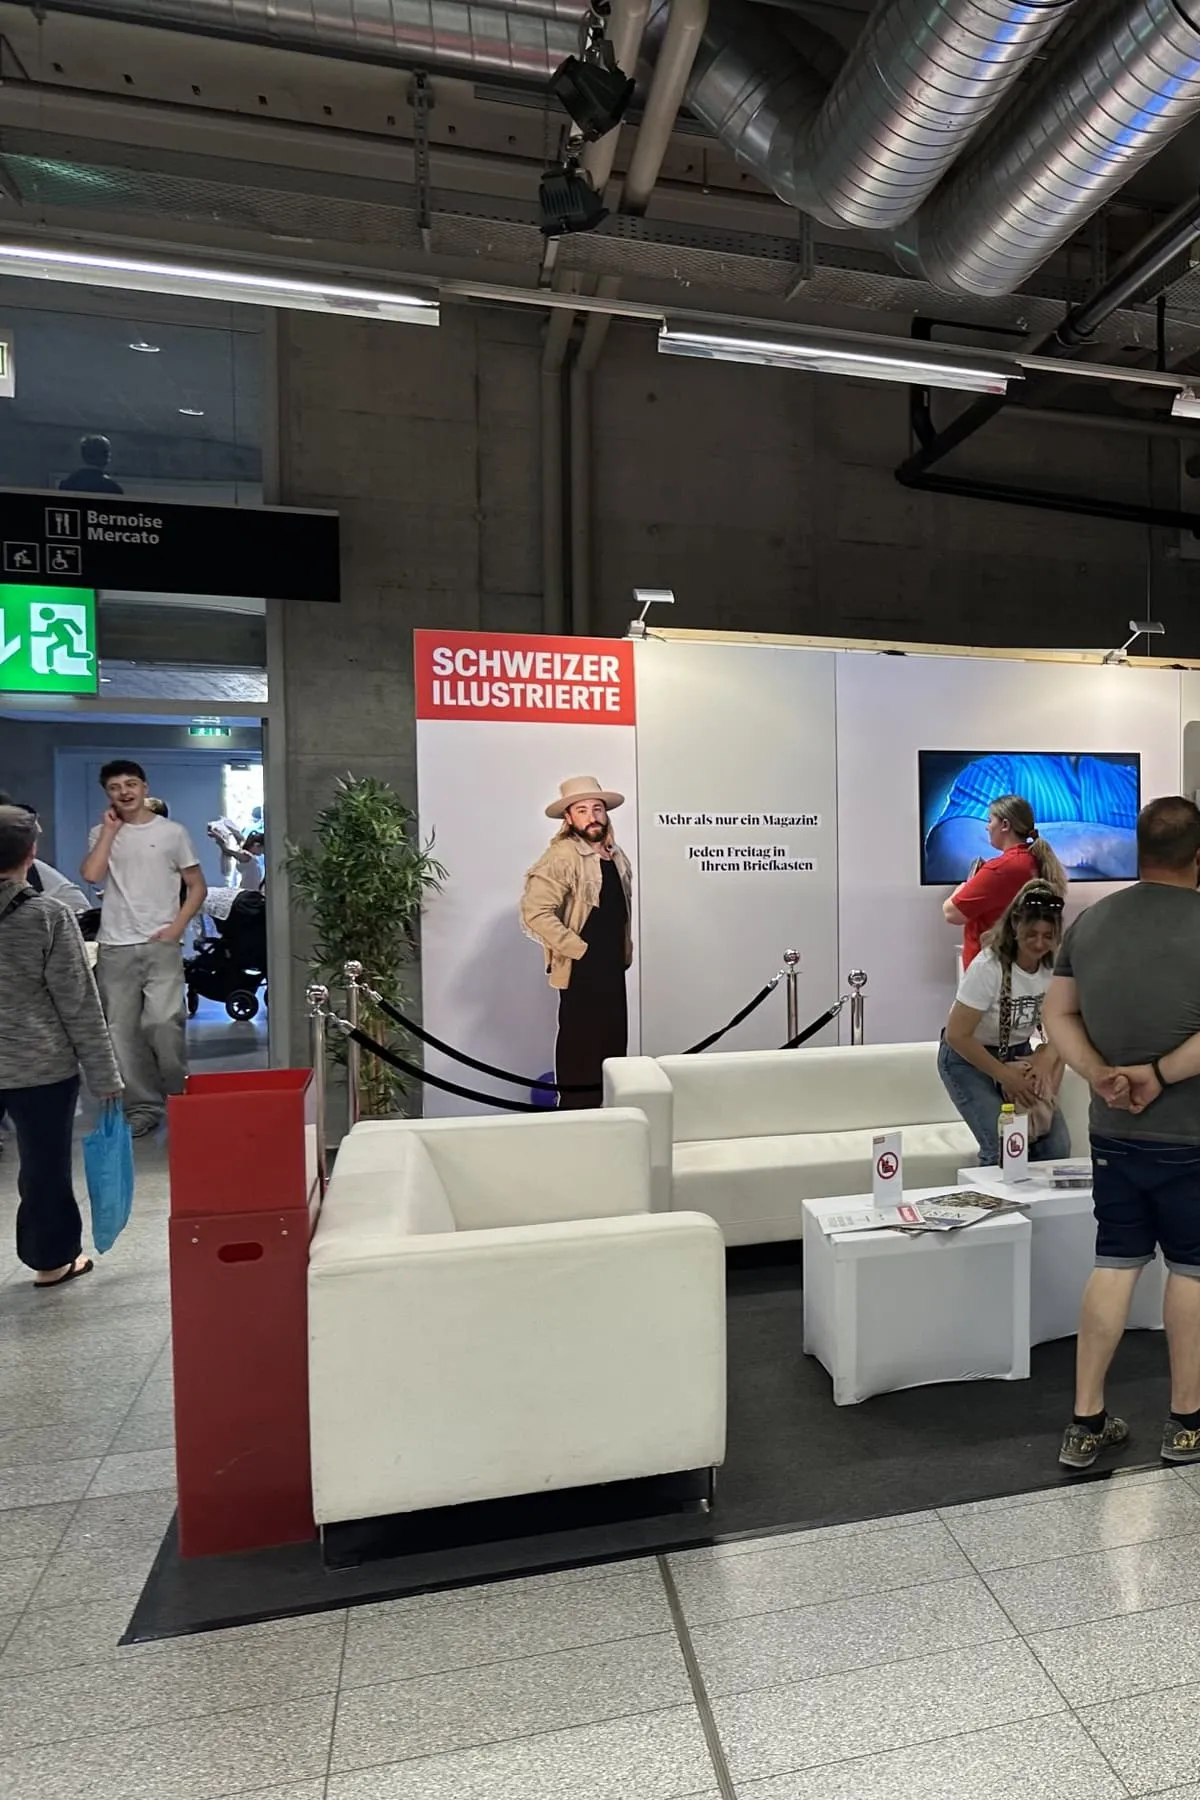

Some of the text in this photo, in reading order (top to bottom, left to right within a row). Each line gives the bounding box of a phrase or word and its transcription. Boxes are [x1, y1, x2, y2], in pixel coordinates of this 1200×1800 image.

[87, 510, 163, 528] Bernoise
[87, 527, 160, 544] Mercato
[432, 647, 620, 683] SCHWEIZER
[432, 680, 621, 712] ILLUSTRIERTE
[658, 814, 818, 828] Mehr als nur ein Magazin!
[688, 846, 786, 859] Jeden Freitag in
[701, 860, 813, 871] Ihrem Briefkasten
